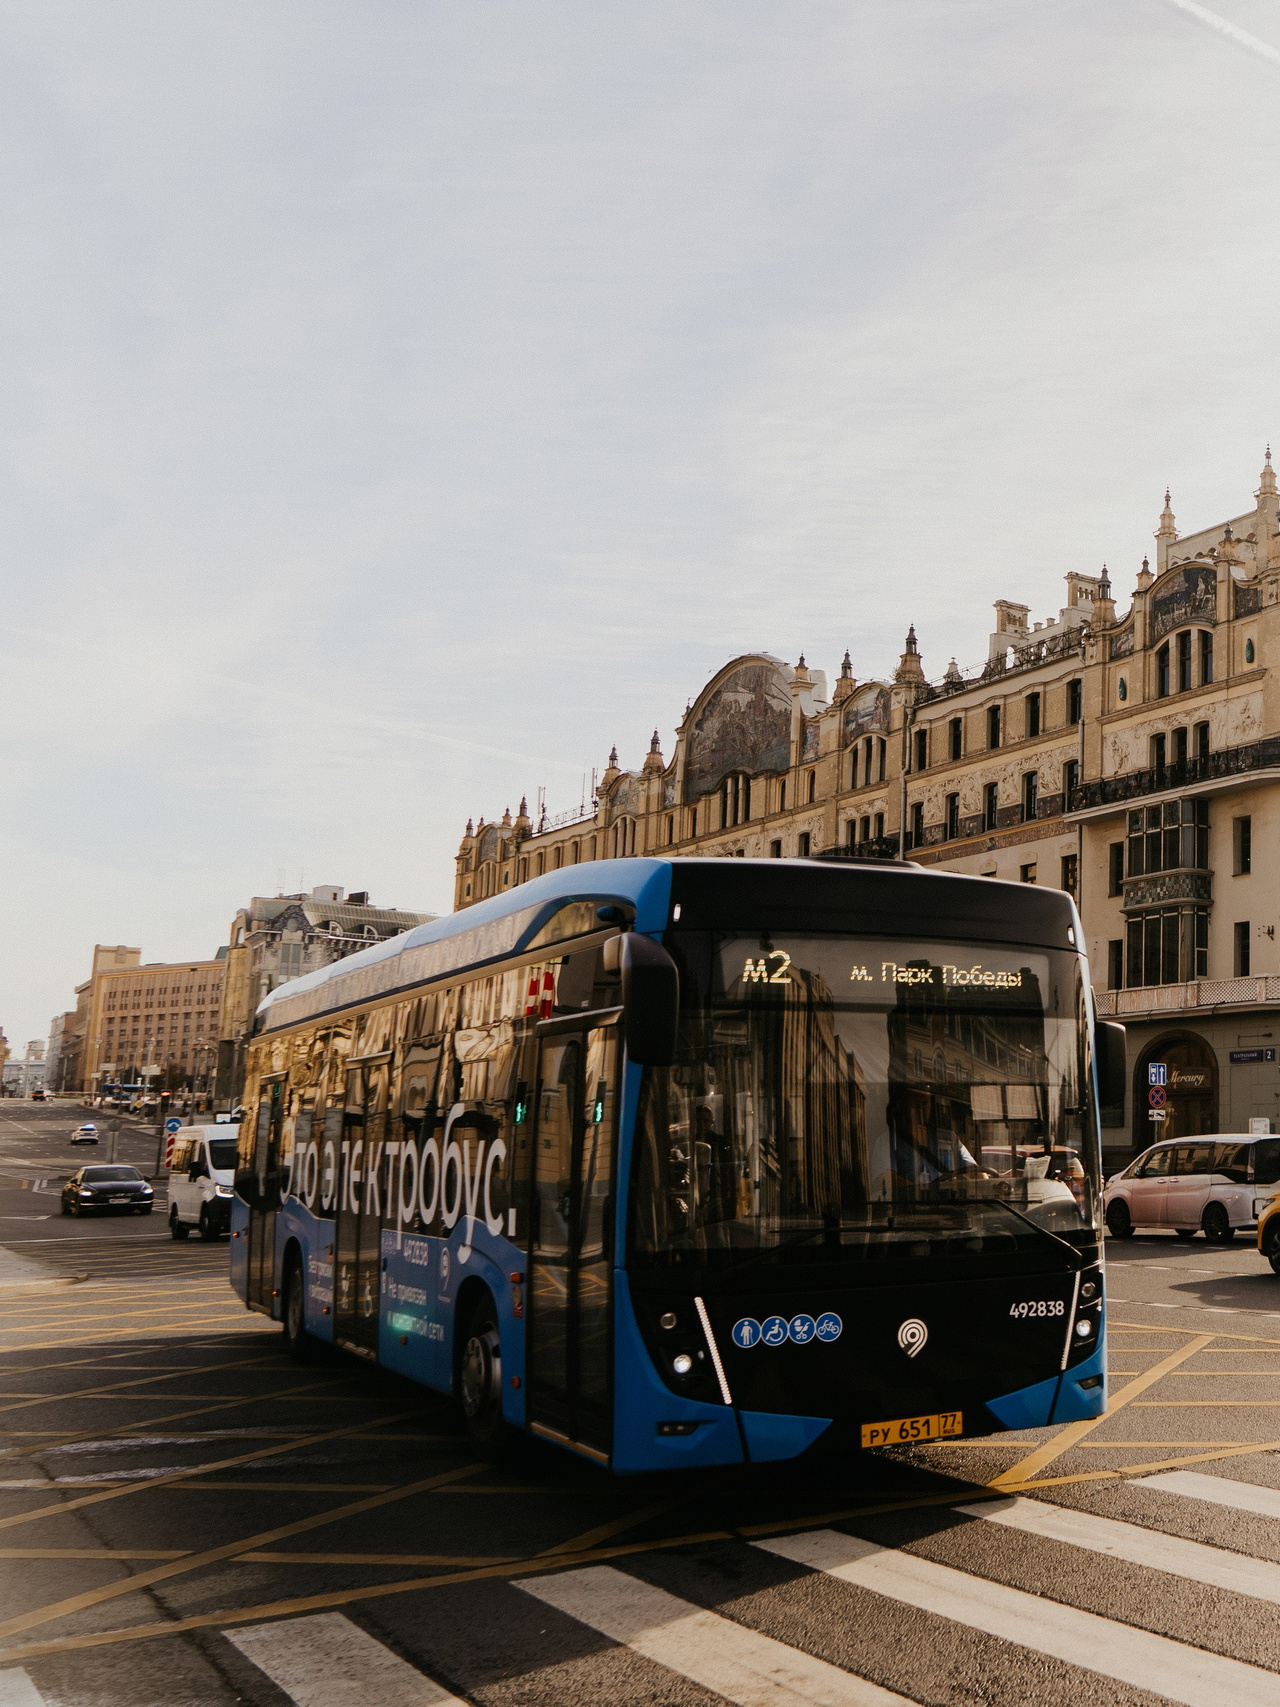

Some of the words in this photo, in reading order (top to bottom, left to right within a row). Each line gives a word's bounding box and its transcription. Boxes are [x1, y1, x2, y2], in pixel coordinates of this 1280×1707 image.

[850, 965, 873, 981] м.
[881, 962, 934, 986] Парк
[942, 965, 1022, 989] Победы
[1267, 1050, 1272, 1059] 2
[1169, 1070, 1205, 1086] Mercury
[1009, 1300, 1065, 1318] 492838
[899, 1418, 931, 1439] 651
[941, 1414, 957, 1429] 77
